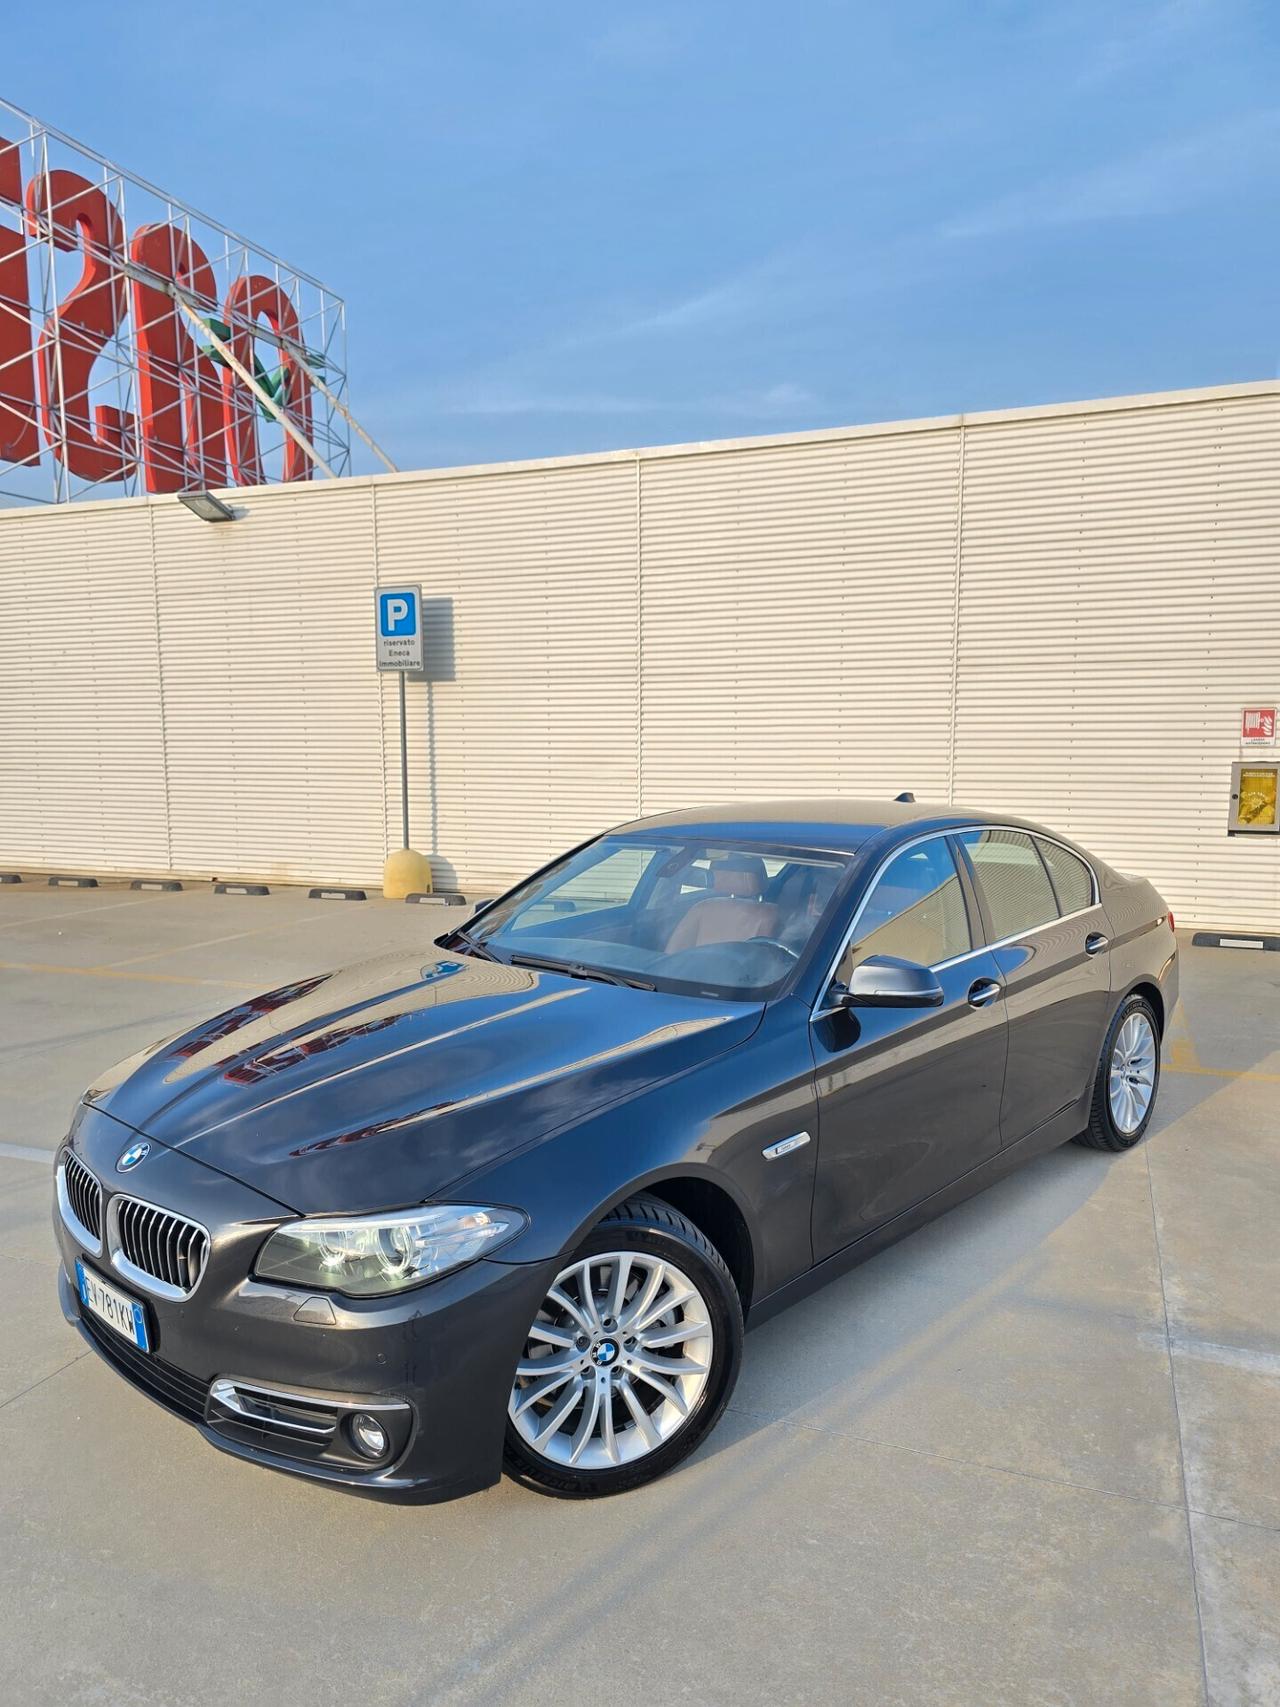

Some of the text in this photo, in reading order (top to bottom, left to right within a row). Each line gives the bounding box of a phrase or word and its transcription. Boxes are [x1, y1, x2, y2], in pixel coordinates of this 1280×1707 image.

[387, 599, 408, 631] P
[384, 638, 416, 647] riservato
[389, 649, 410, 657] Eneca
